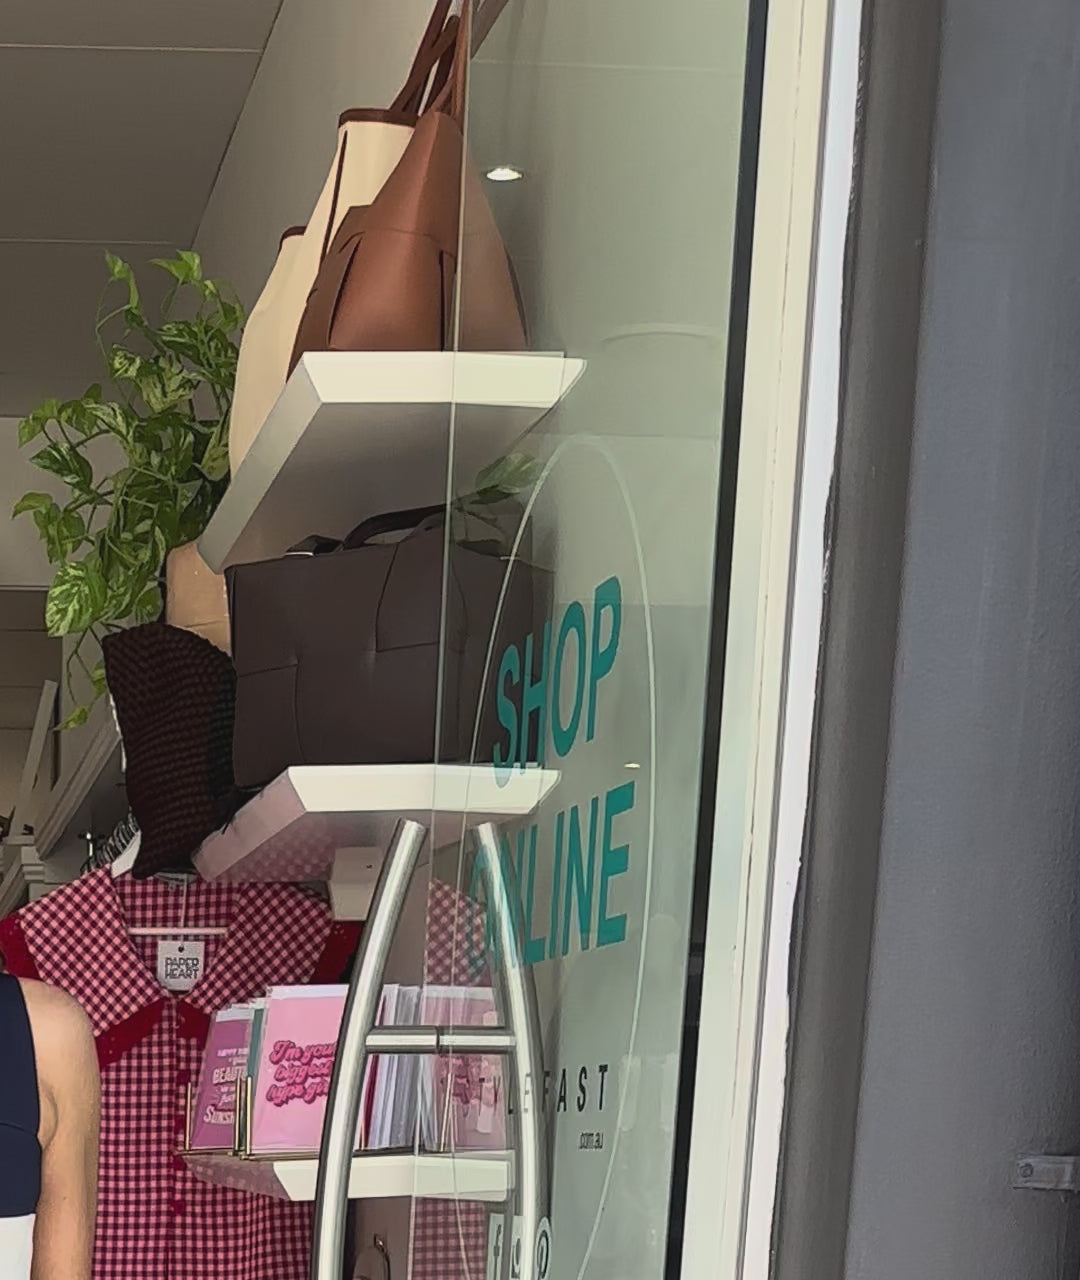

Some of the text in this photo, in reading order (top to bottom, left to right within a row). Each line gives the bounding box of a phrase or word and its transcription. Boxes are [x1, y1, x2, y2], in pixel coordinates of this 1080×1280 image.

[493, 576, 622, 788] SHOP
[470, 781, 635, 976] ONLINE
[165, 957, 200, 969] PAPER
[165, 966, 200, 979] HEART
[302, 1042, 335, 1065] you
